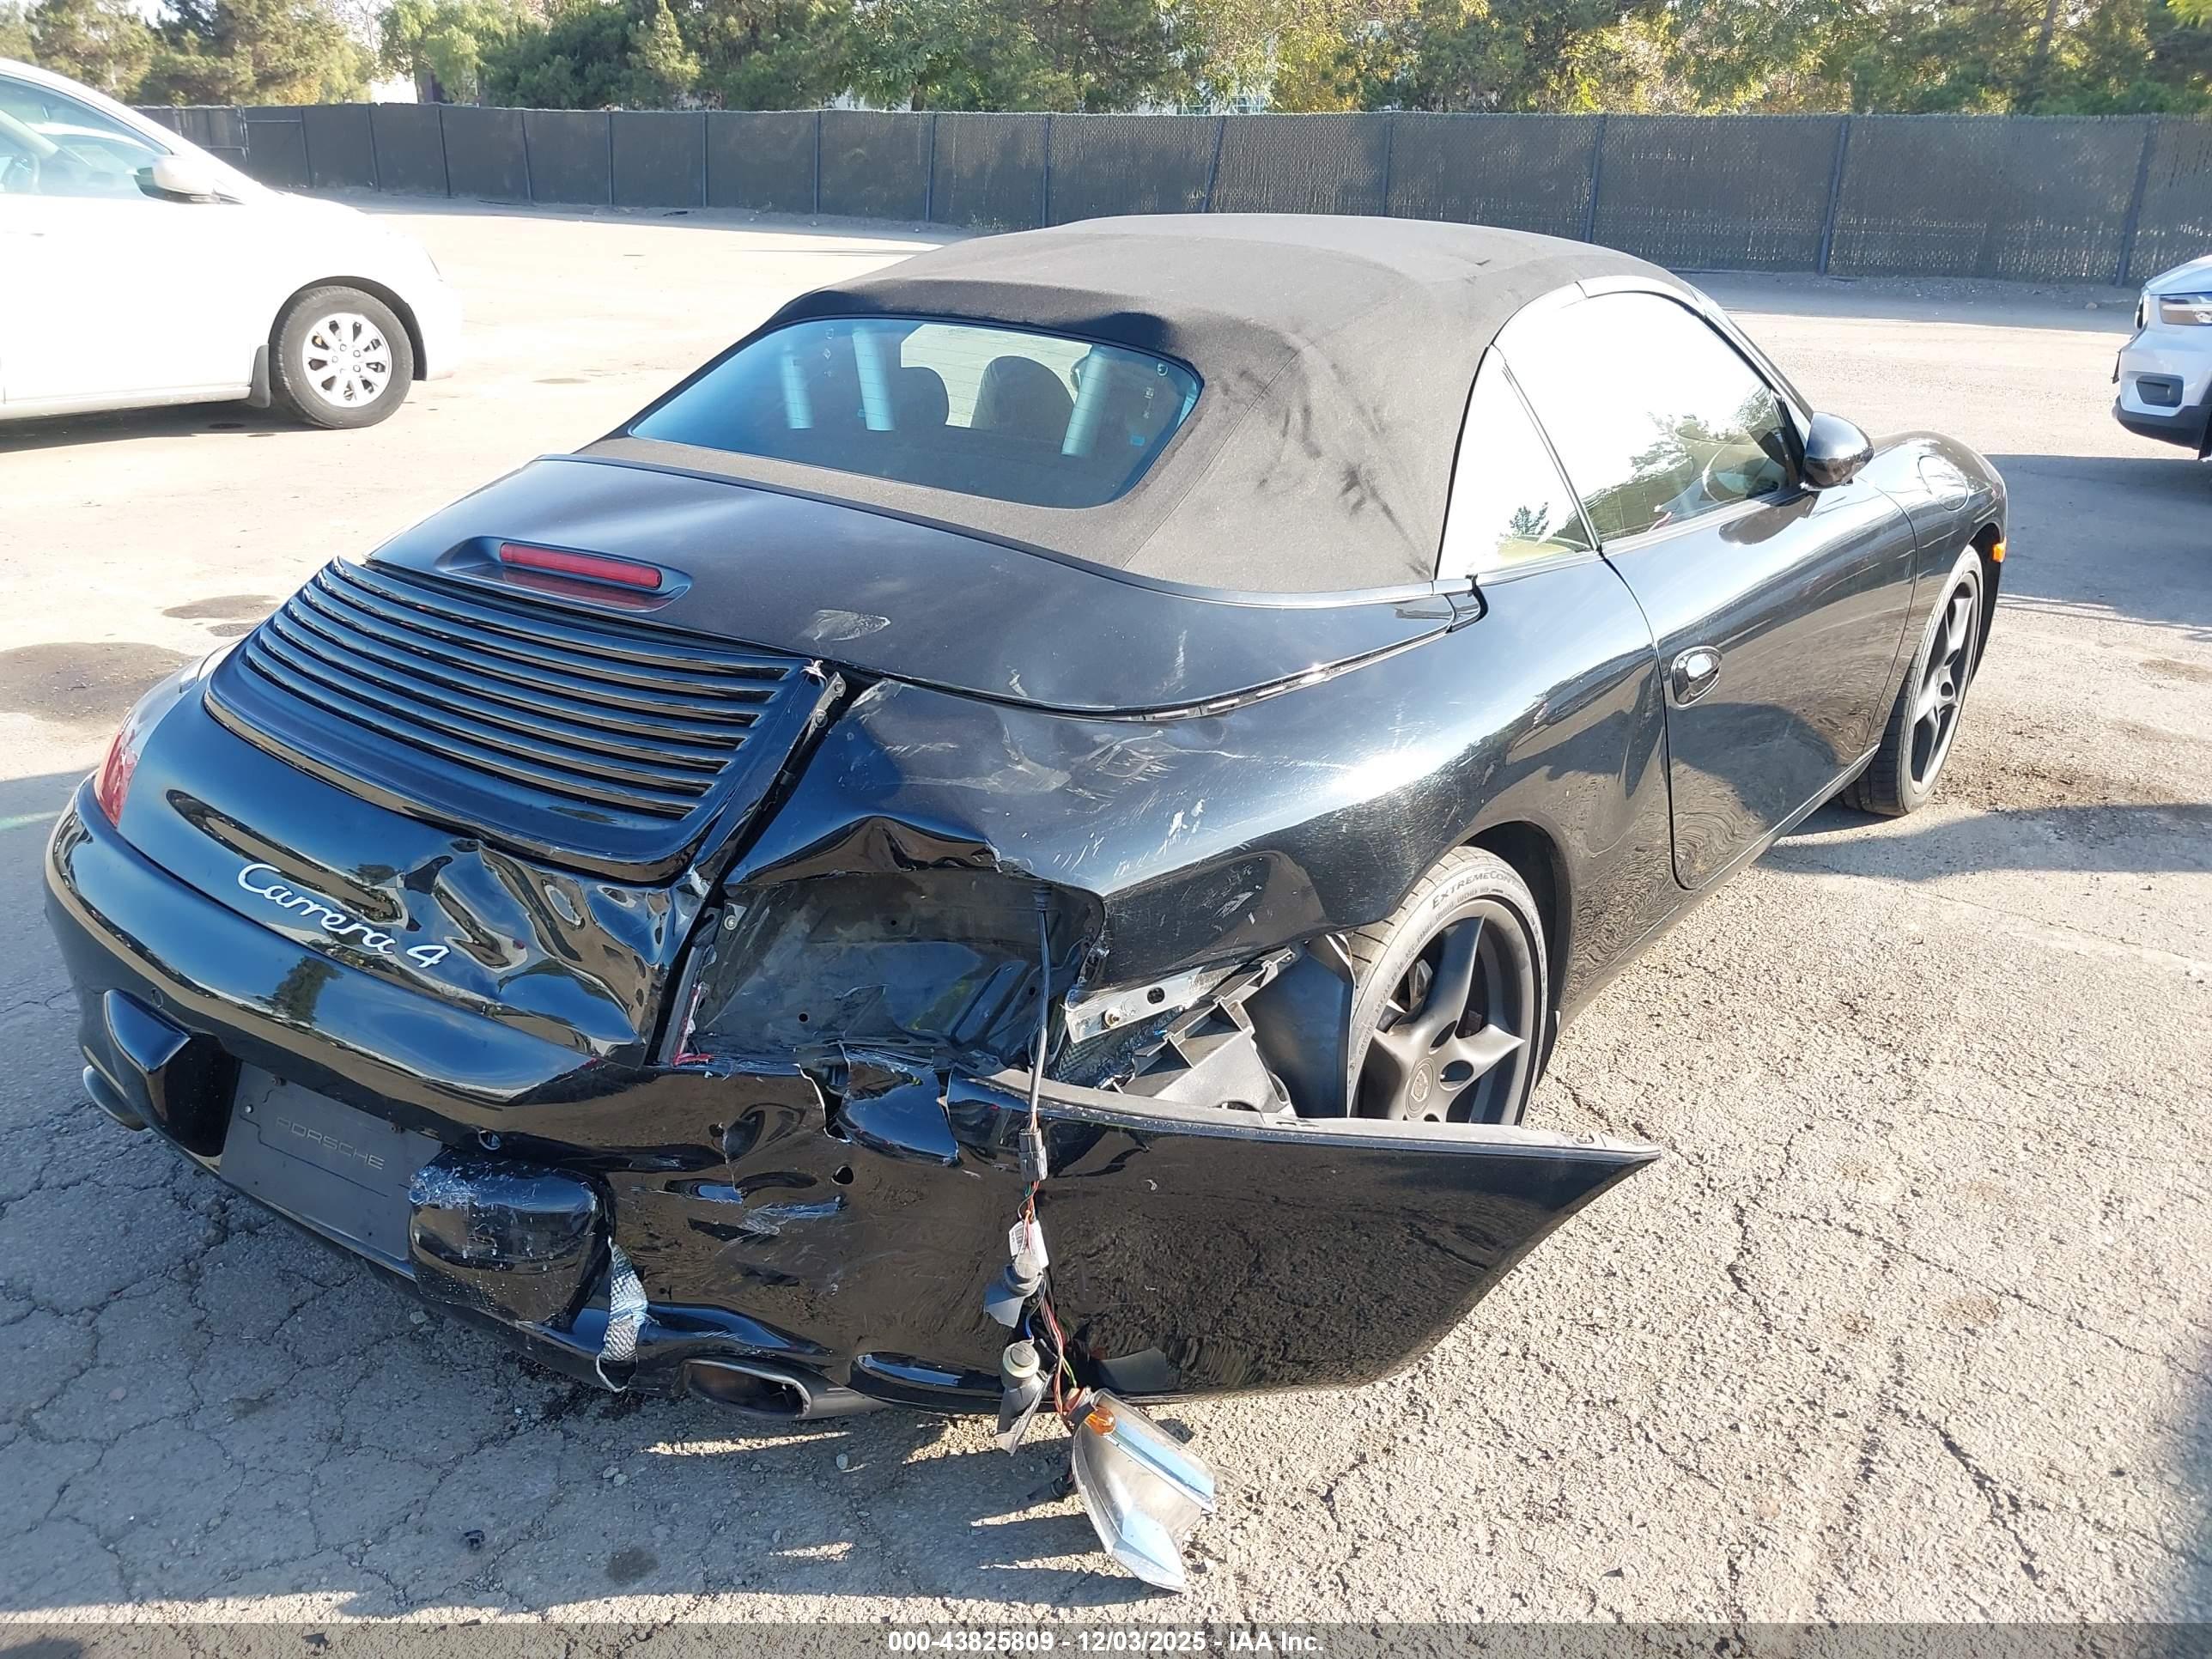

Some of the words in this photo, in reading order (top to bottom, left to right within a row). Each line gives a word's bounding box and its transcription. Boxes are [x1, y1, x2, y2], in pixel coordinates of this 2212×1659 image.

[237, 862, 397, 955] Carrera
[405, 944, 451, 968] 4
[275, 1116, 386, 1170] PORSCHE
